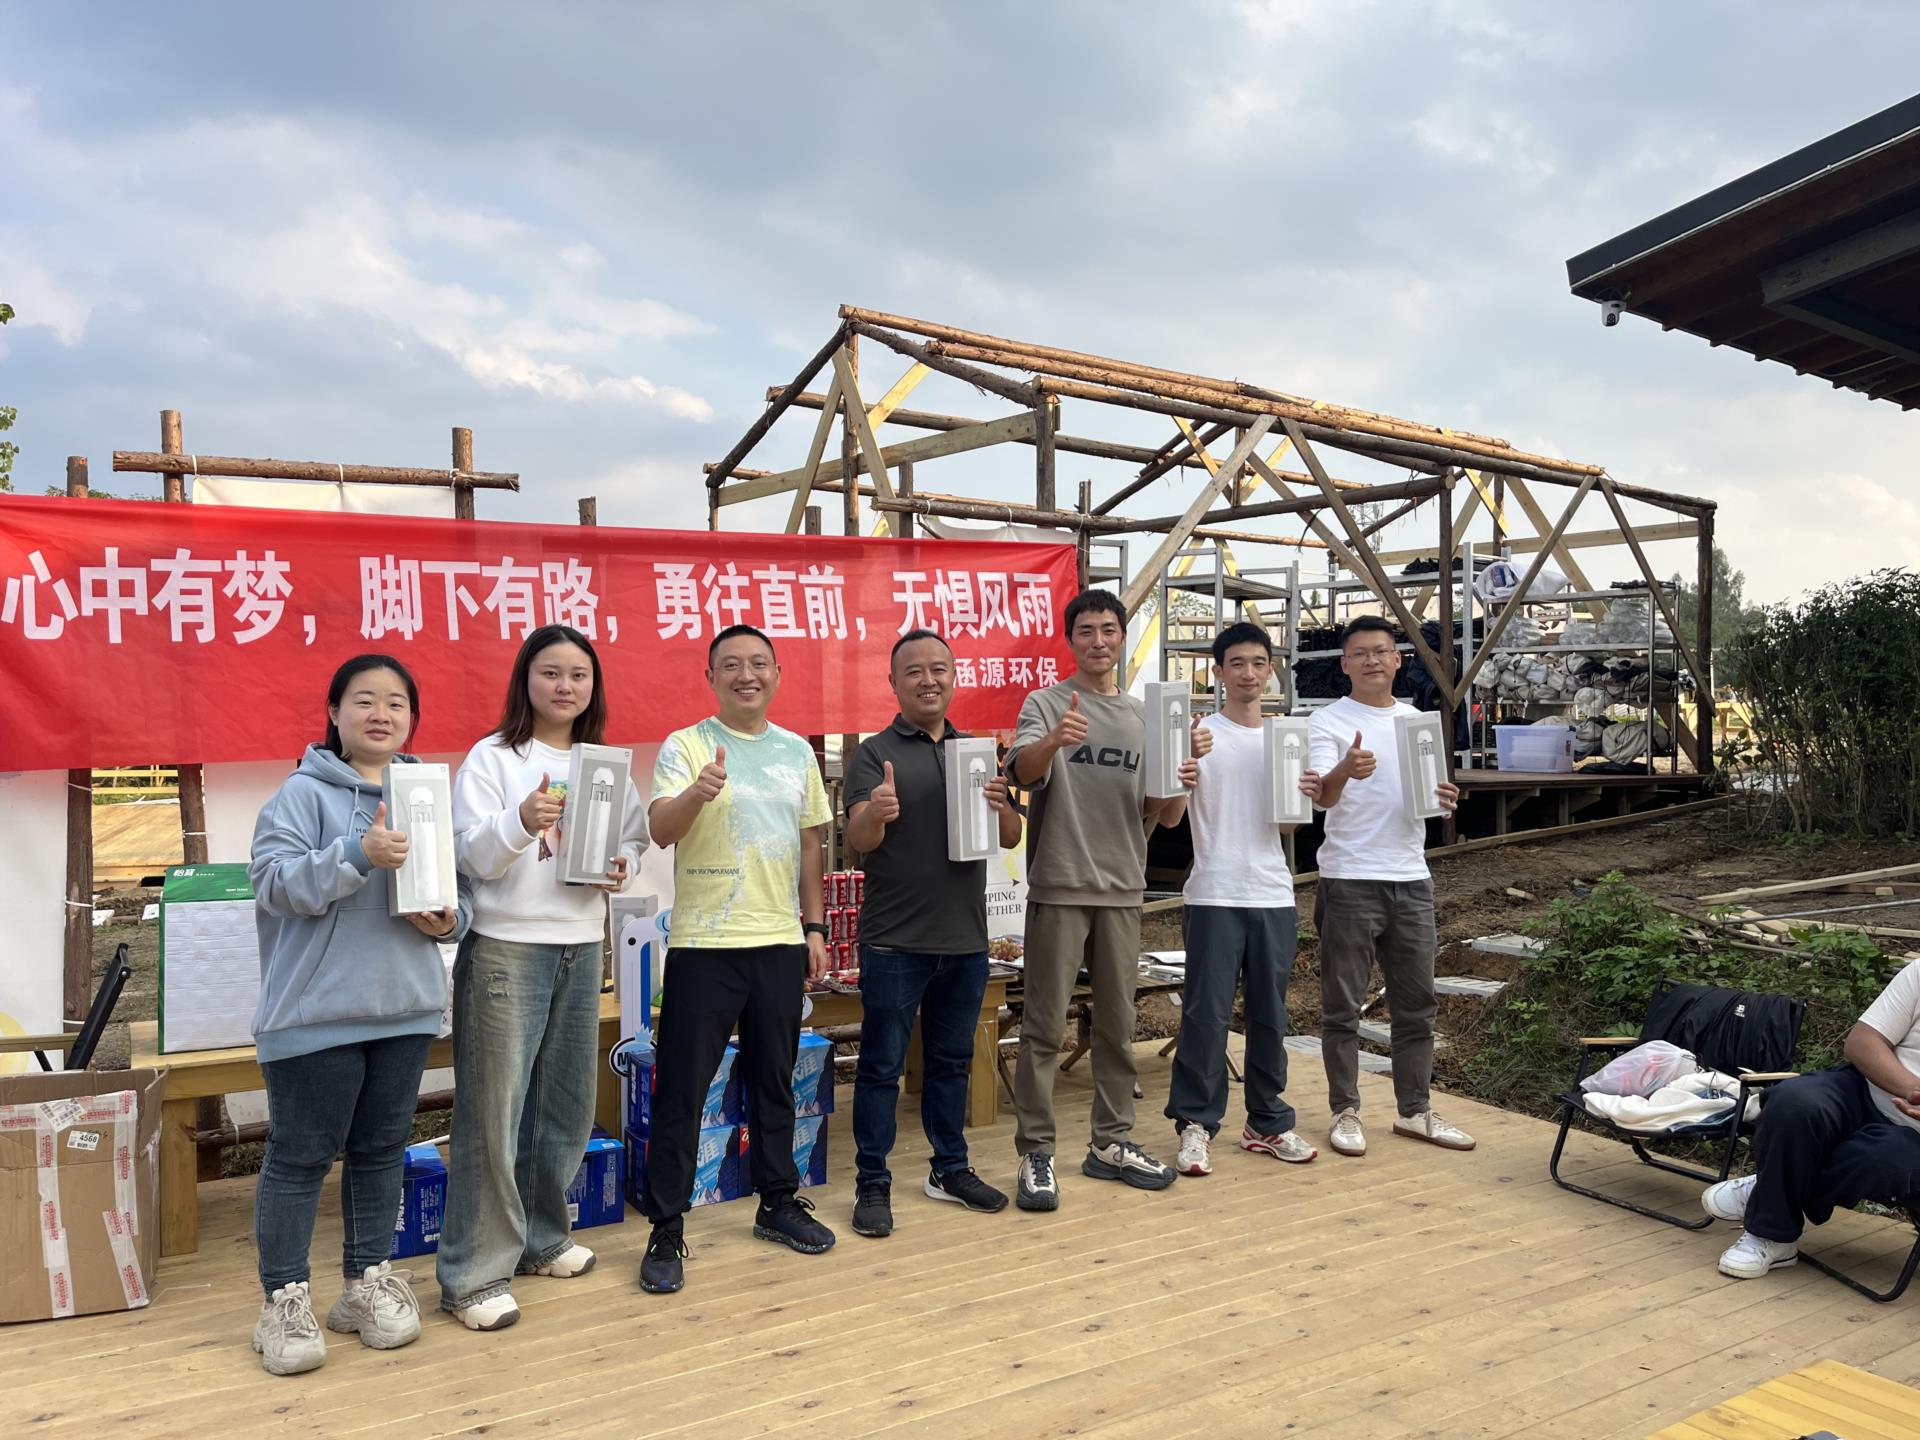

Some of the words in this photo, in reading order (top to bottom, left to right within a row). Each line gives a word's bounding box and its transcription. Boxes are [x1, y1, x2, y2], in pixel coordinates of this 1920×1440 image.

[1, 546, 318, 646] 心中有梦，
[892, 568, 1055, 640] 无惧风雨
[953, 656, 1060, 689] 涵源环保
